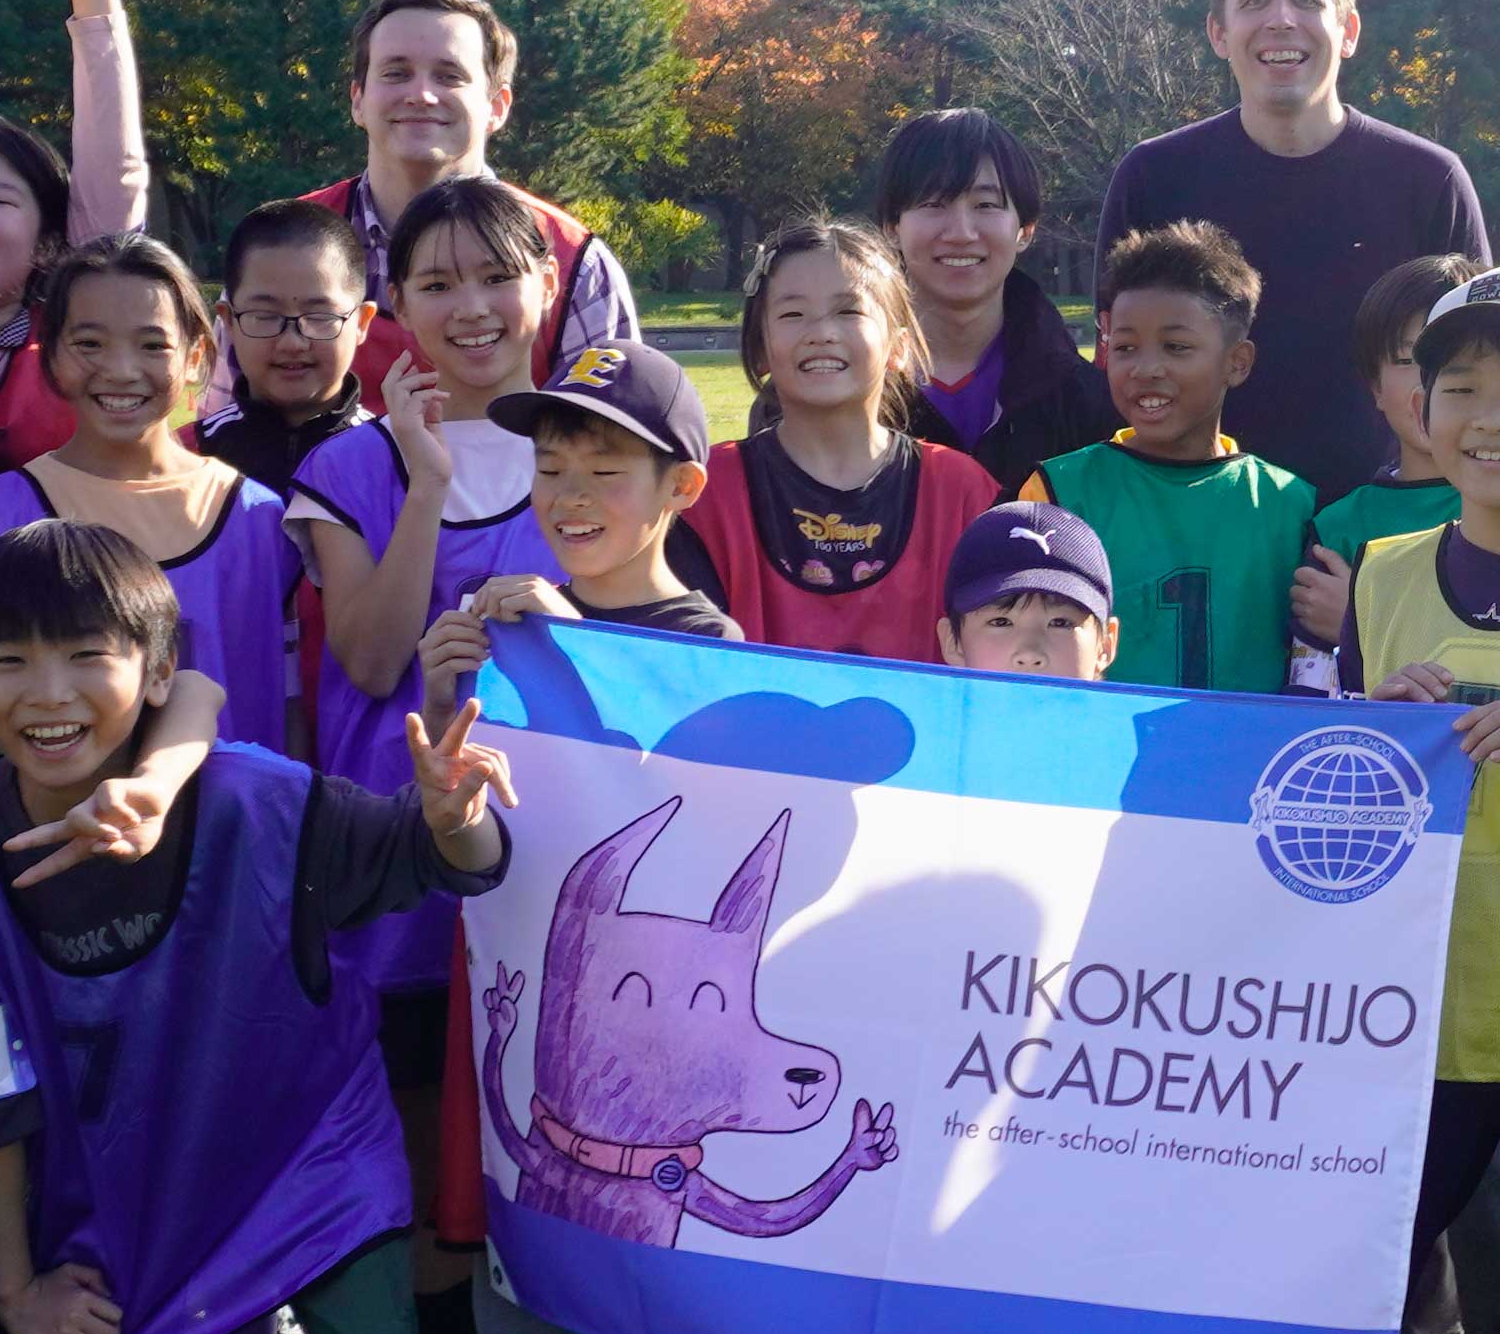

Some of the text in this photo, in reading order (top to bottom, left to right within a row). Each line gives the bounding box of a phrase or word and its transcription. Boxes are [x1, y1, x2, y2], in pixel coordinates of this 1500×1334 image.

[832, 540, 866, 553] YEARS
[1156, 566, 1213, 689] 1
[1299, 733, 1396, 762] THE AFTER-SCHOOL
[1273, 805, 1410, 826] KIKOKUSHIJO ACADEMY
[1273, 866, 1390, 902] INTERNATIONAL SCHOOL
[961, 950, 1417, 1048] KIKOKUSHIJO
[944, 1030, 1304, 1122] ACADEMY
[942, 1110, 1387, 1176] the after-school international school
